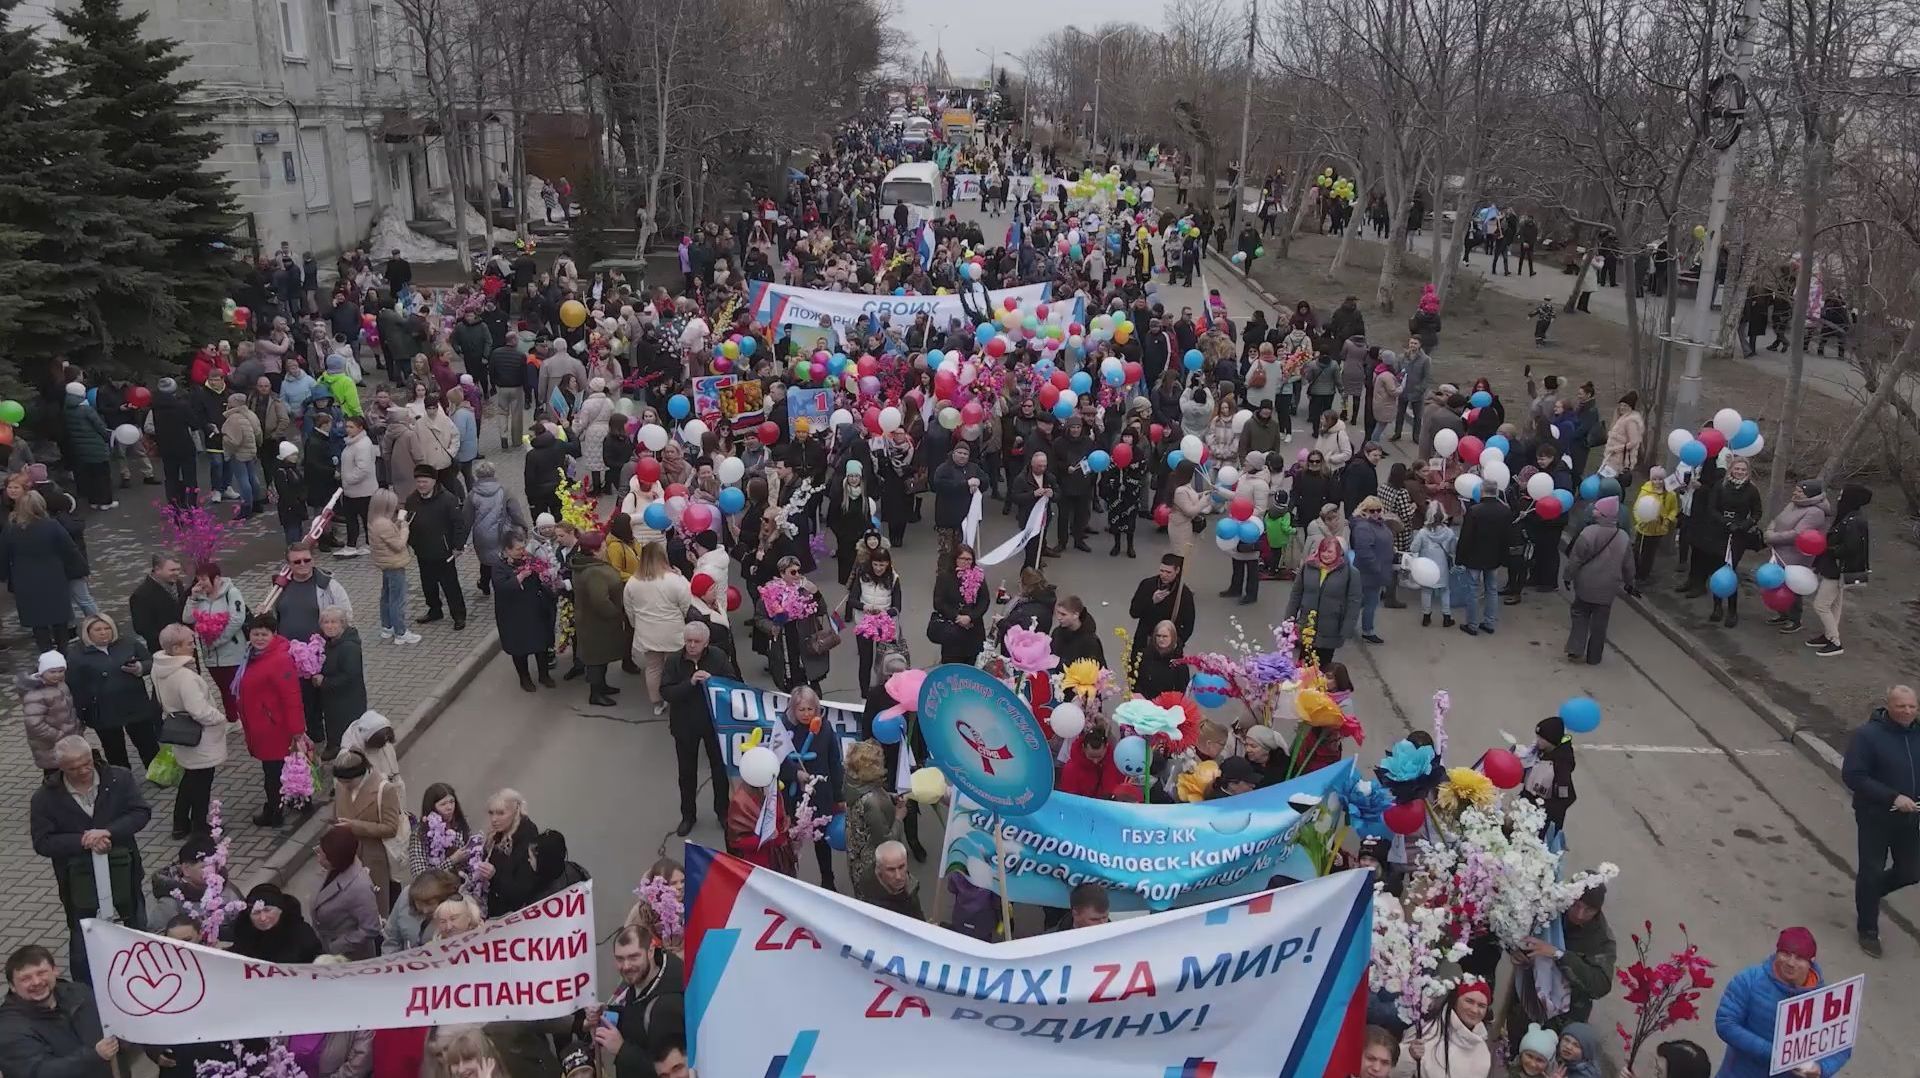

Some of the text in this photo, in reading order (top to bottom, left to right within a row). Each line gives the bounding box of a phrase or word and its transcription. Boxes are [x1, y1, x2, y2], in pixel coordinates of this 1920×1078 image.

[789, 306, 857, 327] ПОЖРН
[815, 393, 827, 411] 1
[1122, 828, 1196, 844] ГБУЗ КК
[243, 929, 588, 980] КАИОЛОГИЧЕСКИЙ
[839, 944, 1072, 1006] НАШИХ!
[1176, 926, 1322, 993] МИР!
[405, 972, 590, 1017] ДИСПАНСЕР
[1785, 984, 1854, 1036] МЫ
[950, 1004, 1210, 1043] РОДИНУ!
[1781, 1019, 1849, 1066] ВМЕСТЕ
